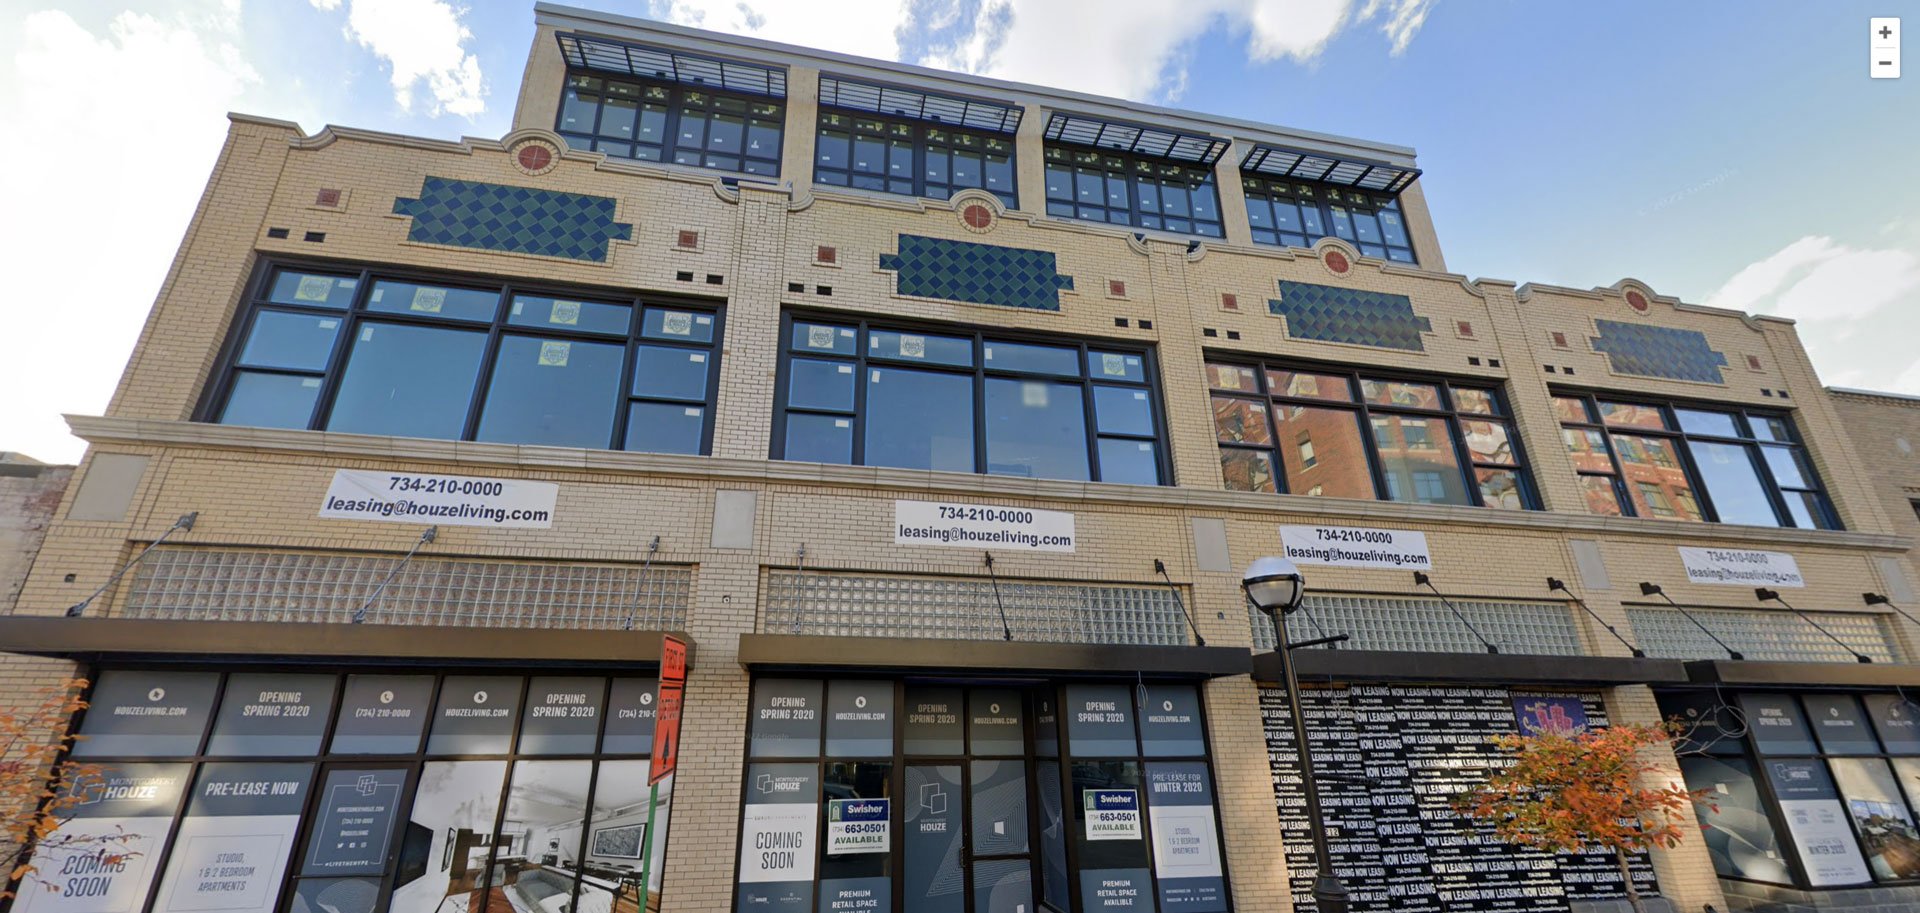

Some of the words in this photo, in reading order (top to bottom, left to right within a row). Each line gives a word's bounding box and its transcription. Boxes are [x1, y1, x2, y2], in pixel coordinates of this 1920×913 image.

[389, 477, 503, 497] 734-210-0000
[326, 495, 549, 522] leasing@houzeliving.com
[939, 506, 1033, 524] 734-210-0000
[899, 524, 1071, 547] leasing@houzeliving.com
[1315, 528, 1393, 544] 734-210-0000
[1286, 546, 1428, 565] leasing@houzeliving.com
[1707, 551, 1768, 565] 734-210-0000
[1266, 689, 1287, 697] LEASING
[1363, 686, 1390, 695] LEASING
[1406, 688, 1431, 696] LEASING
[1446, 689, 1471, 697] LEASING
[1485, 689, 1509, 698] LEASING
[258, 691, 302, 703] OPENING
[546, 693, 586, 705] OPENING
[771, 697, 806, 707] OPENING
[243, 705, 280, 717] SPRING
[282, 705, 310, 717] 2020
[917, 704, 947, 713] OPENING
[1085, 701, 1115, 711] OPENING
[114, 706, 188, 717] HOUZELIVING.COM
[355, 708, 376, 718] (734)
[378, 708, 411, 718] 210-0000
[445, 708, 509, 718] HOUZELIVING.COM
[532, 706, 567, 718] SPRING
[570, 706, 595, 717] 2020
[618, 708, 637, 719] (734)
[760, 709, 791, 720] SPRING
[793, 709, 815, 720] 2020
[835, 712, 886, 721] HOUZELIVING.COM
[1411, 712, 1436, 720] LEASING
[1437, 712, 1451, 720] NOW
[1451, 712, 1476, 720] LEASING
[1491, 712, 1515, 720] LEASING
[909, 714, 935, 724] SPRING
[936, 714, 956, 724] 2020
[973, 717, 1018, 725] HOUZELIVING.COM
[1078, 713, 1104, 722] SPRING
[1106, 713, 1124, 722] 2020
[1368, 712, 1396, 722] LEASING
[1374, 739, 1402, 749] LEASING
[1402, 736, 1416, 744] NOW
[1417, 735, 1442, 744] LEASING
[1443, 735, 1457, 744] NOW
[1457, 735, 1482, 744] LEASING
[1312, 753, 1333, 761] LEASING
[1422, 760, 1447, 768] LEASING
[1381, 767, 1409, 777] LEASING
[1153, 774, 1187, 782] PRE-LEASE
[1188, 773, 1201, 781] FOR
[205, 781, 268, 797] PRE-LEASE
[271, 781, 300, 796] NOW
[774, 782, 801, 791] HOUZE
[1154, 782, 1182, 793] WINTER
[1183, 782, 1202, 792] 2020
[1414, 785, 1427, 794] NOW
[1427, 785, 1454, 794] LEASING
[1454, 784, 1468, 793] NOW
[104, 786, 157, 800] HOUZE
[1100, 794, 1132, 803] Swisher
[1284, 798, 1306, 806] LEASING
[1319, 798, 1341, 806] LEASING
[1387, 795, 1415, 806] LEASING
[847, 804, 883, 814] Swisher
[1100, 812, 1136, 822] 663-0501
[1420, 811, 1433, 820] NOW
[845, 824, 886, 833] 663-0501
[920, 822, 947, 832] HOUZE
[1288, 821, 1310, 829] LEASING
[1393, 823, 1421, 835] LEASING
[756, 831, 803, 850] COMING
[834, 835, 883, 845] AVAILABLE
[1425, 837, 1439, 846] NOW
[1440, 836, 1467, 846] LEASING
[1292, 845, 1315, 853] LEASING
[1328, 844, 1350, 853] LEASING
[215, 852, 246, 865] STUDIO,
[761, 851, 795, 870] SOON
[1384, 854, 1399, 866] NOW
[1399, 853, 1429, 865] LEASING
[63, 854, 128, 876] COMING
[1431, 864, 1446, 873] NOW
[1447, 863, 1474, 873] LEASING
[1474, 863, 1489, 872] NOW
[1489, 861, 1516, 871] LEASING
[1516, 860, 1531, 870] NOW
[1530, 860, 1557, 870] LEASING
[212, 867, 219, 878] 2
[220, 866, 255, 878] BEDROOM
[1595, 872, 1619, 882] LEASING
[1632, 871, 1655, 881] LEASING
[64, 876, 113, 898] SOON
[198, 880, 246, 892] APARTMENTS
[1390, 885, 1406, 896] NOW
[1407, 883, 1436, 896] LEASING
[839, 889, 871, 898] PREMIUM
[1097, 889, 1117, 897] RETAIL
[1453, 889, 1480, 900] LEASING
[1480, 889, 1495, 899] NOW
[1495, 887, 1522, 898] LEASING
[1522, 887, 1538, 897] NOW
[1537, 887, 1564, 897] LEASING
[832, 900, 855, 909] RETAIL
[856, 900, 878, 908] SPACE
